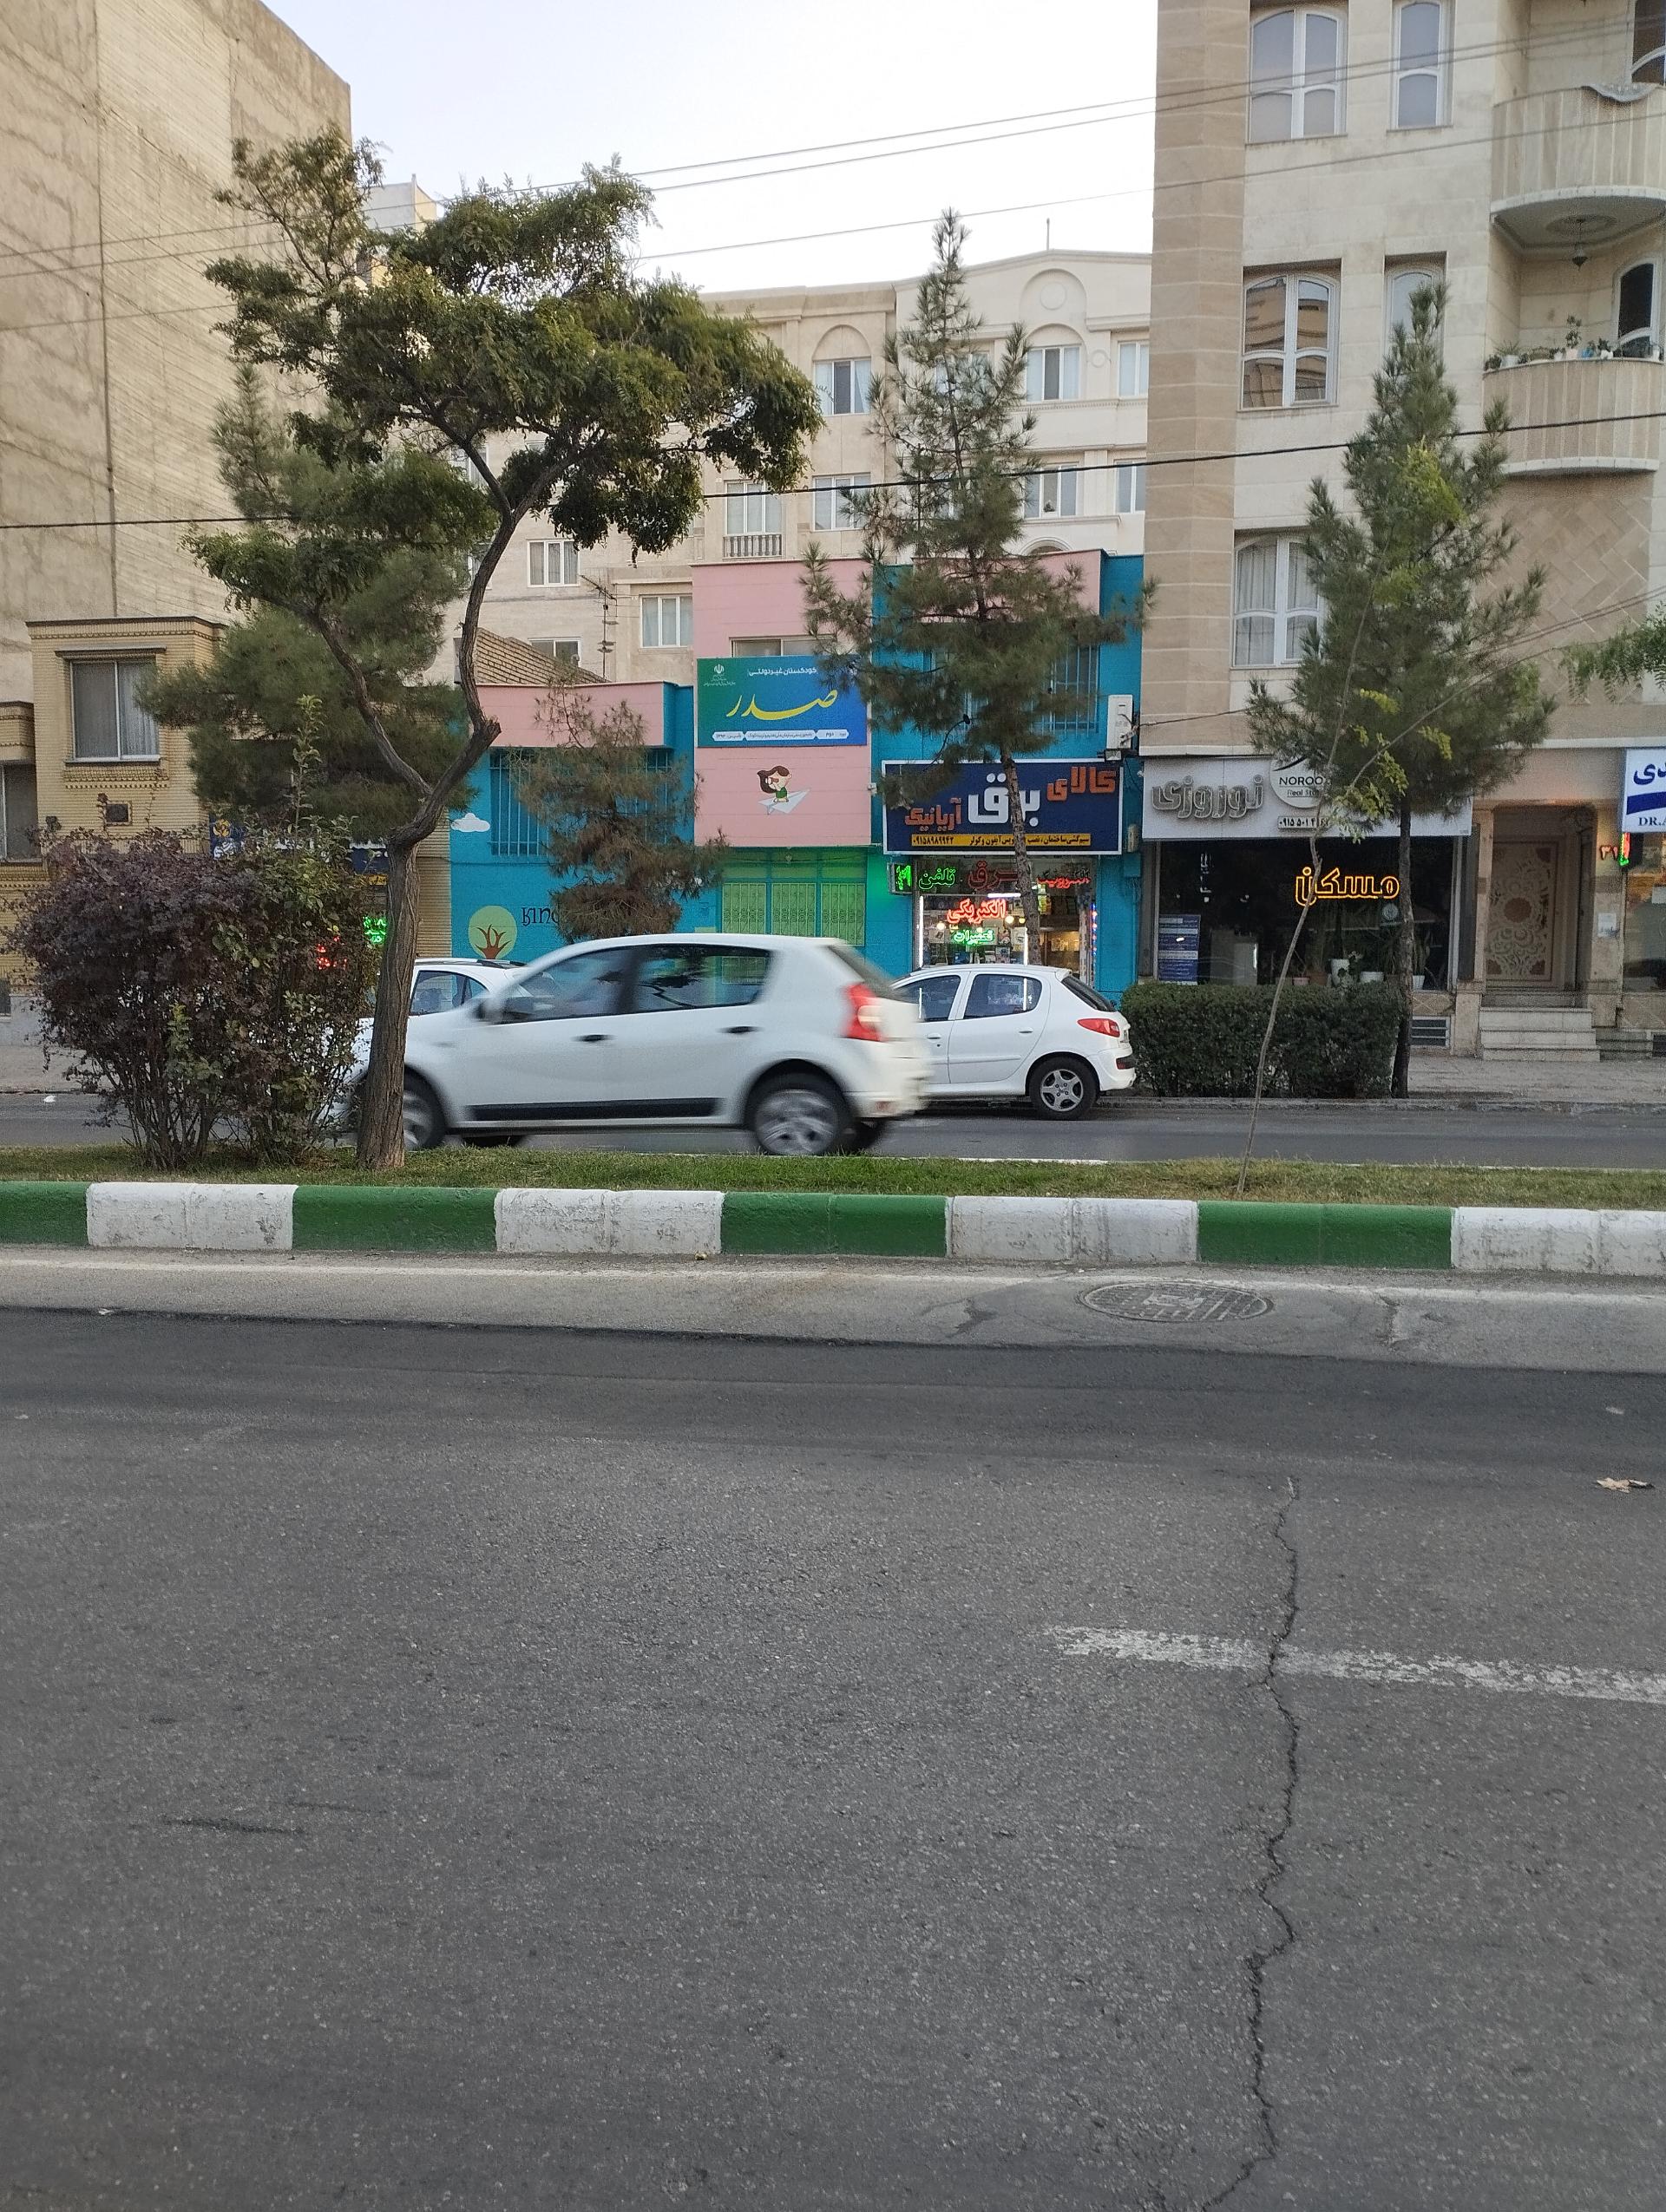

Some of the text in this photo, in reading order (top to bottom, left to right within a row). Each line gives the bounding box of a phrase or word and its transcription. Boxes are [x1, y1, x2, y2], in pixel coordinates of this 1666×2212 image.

[726, 690, 838, 721] صدر
[1046, 766, 1117, 802] کالای
[1151, 775, 1263, 820] نوروزی
[918, 867, 956, 890] تلفن
[1295, 866, 1400, 907] مسکن
[947, 898, 1007, 925] الکتریکی
